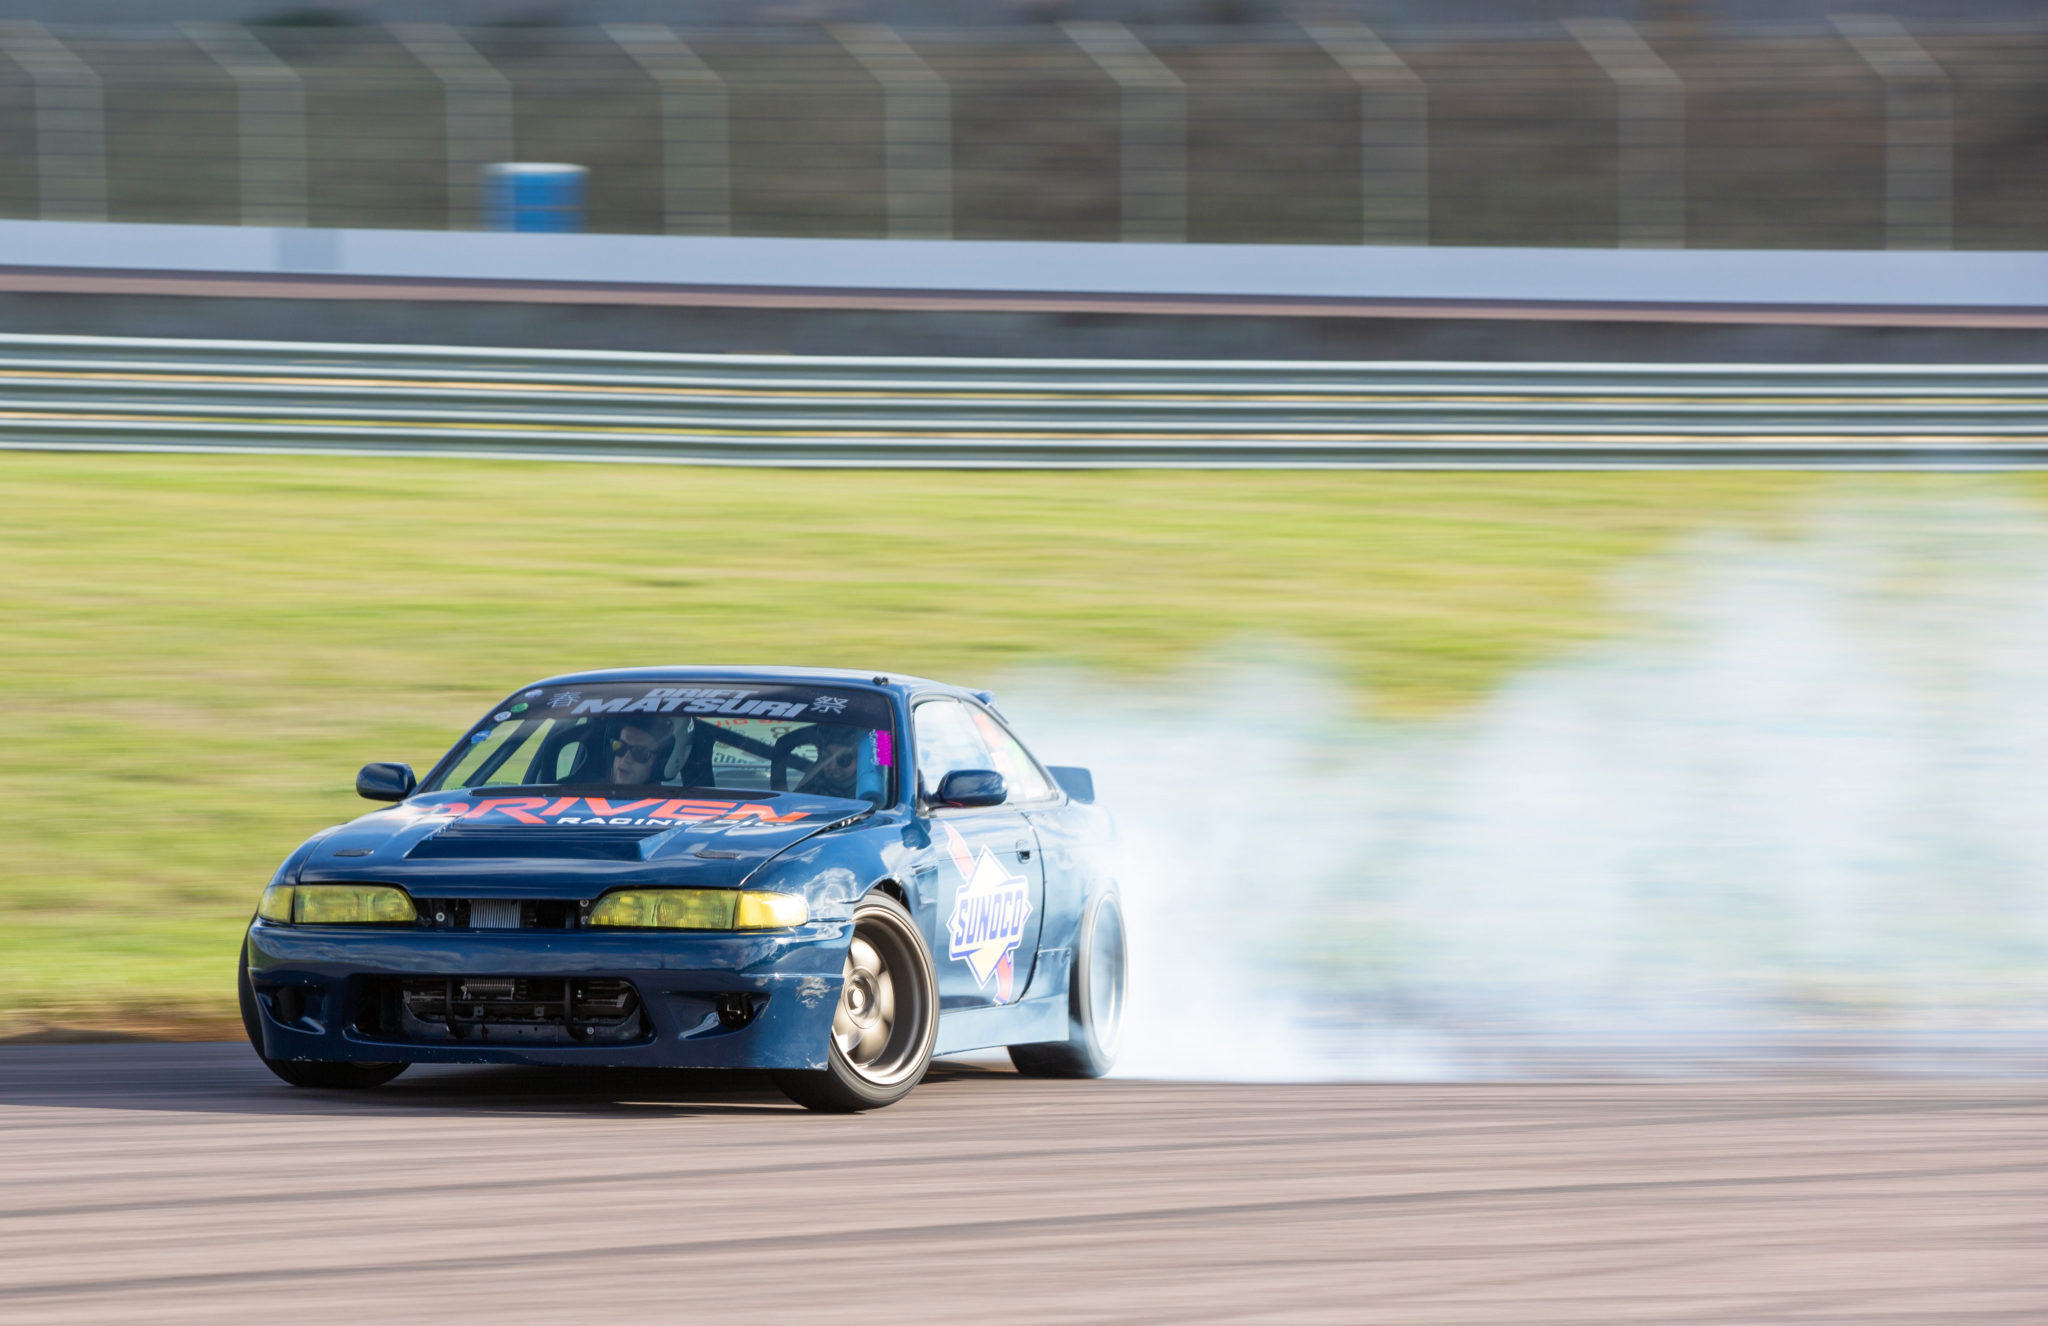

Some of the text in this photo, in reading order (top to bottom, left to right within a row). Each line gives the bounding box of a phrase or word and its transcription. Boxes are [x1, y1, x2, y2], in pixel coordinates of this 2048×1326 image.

[644, 688, 759, 700] DRIFT
[570, 698, 809, 719] MATSURI
[810, 695, 849, 715] 祭
[384, 797, 812, 825] DRIVEN
[955, 890, 1024, 947] SUNOCO
